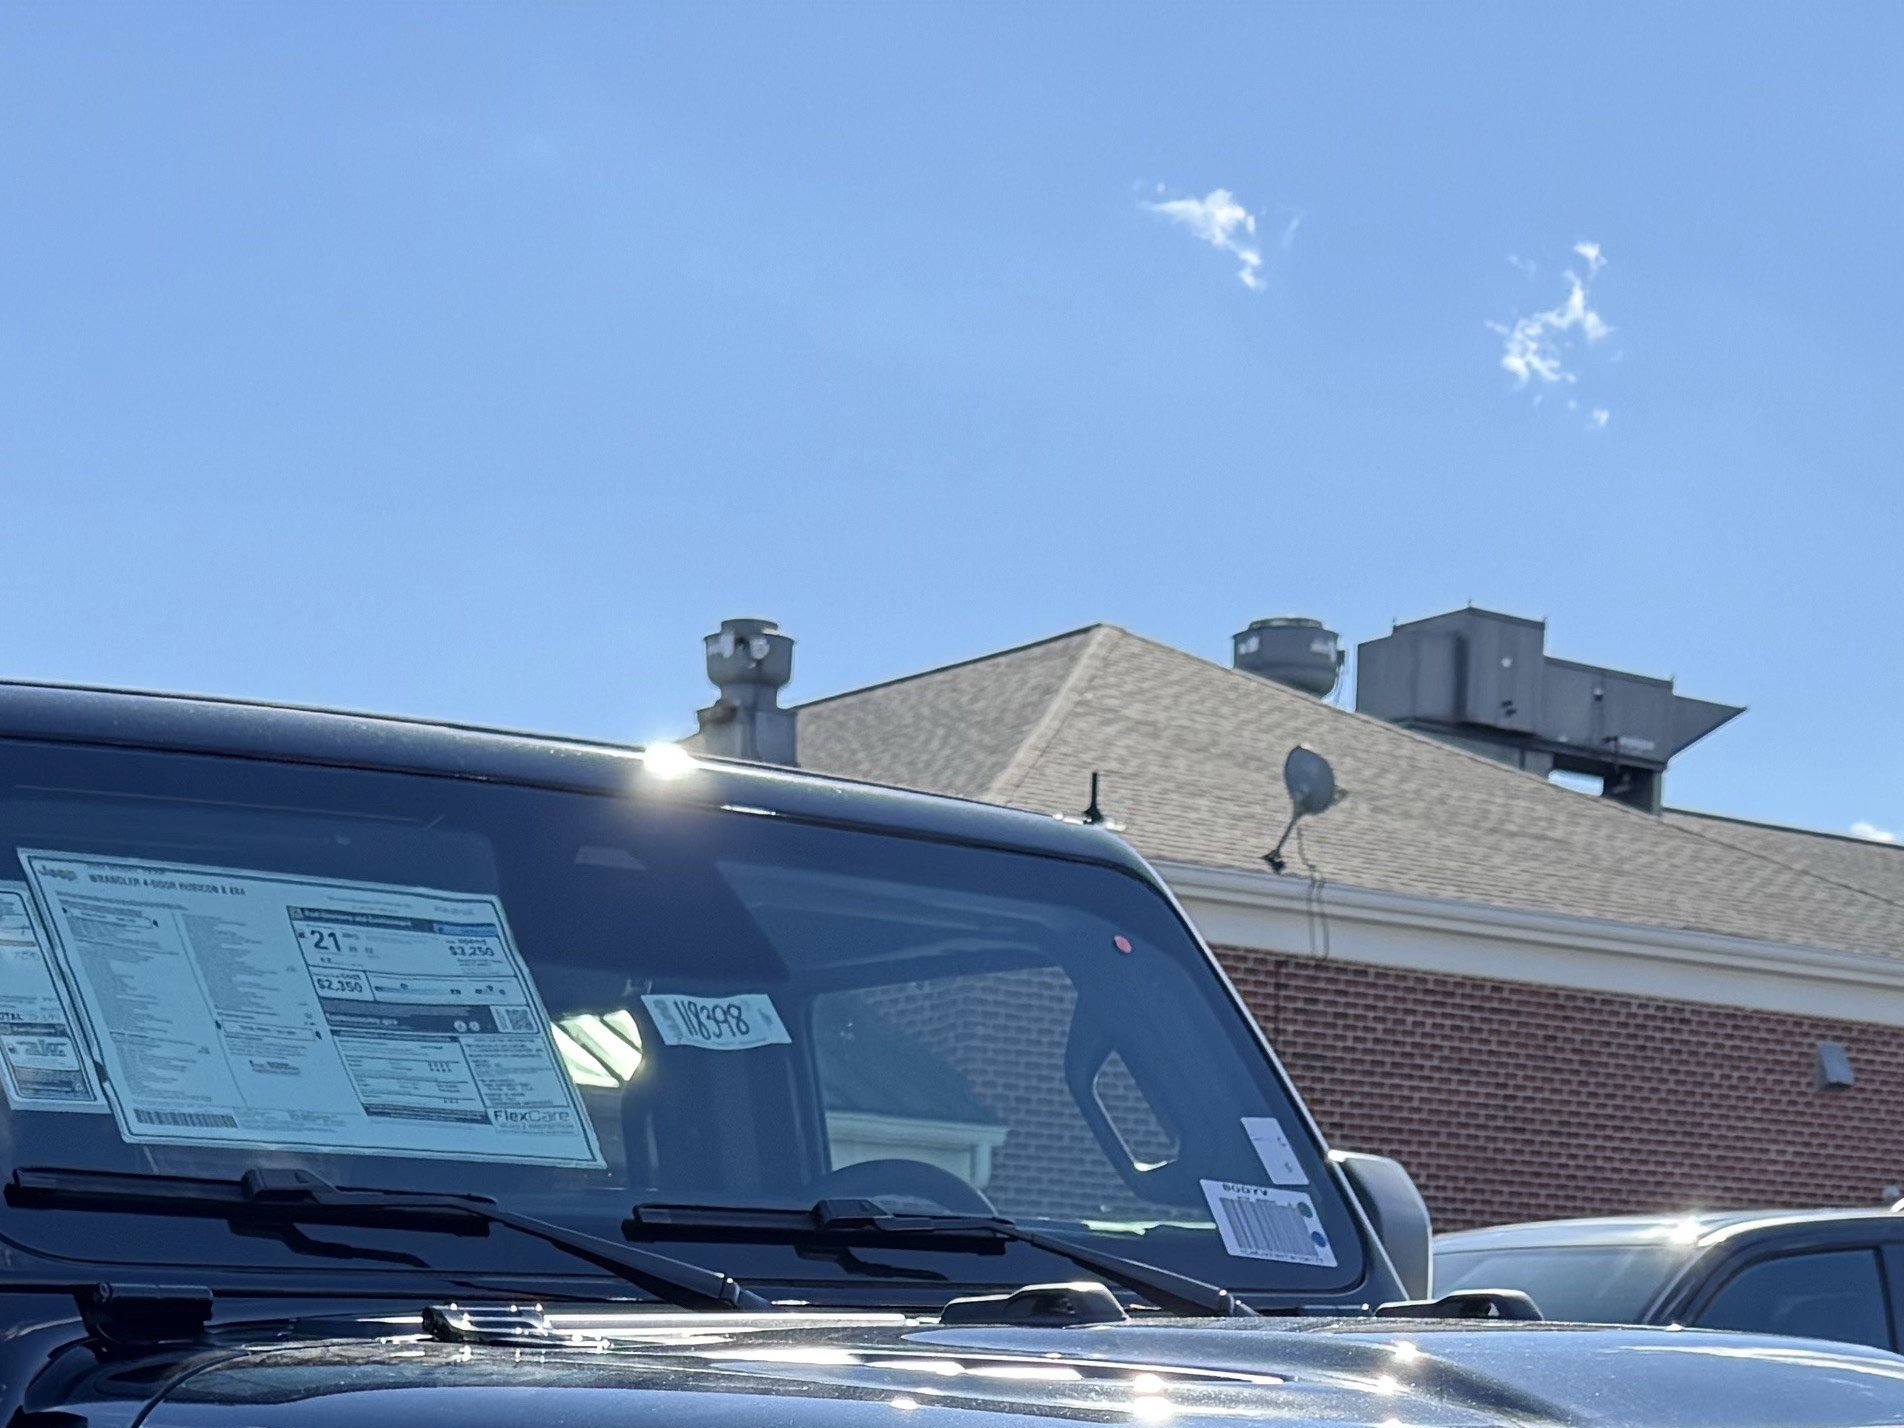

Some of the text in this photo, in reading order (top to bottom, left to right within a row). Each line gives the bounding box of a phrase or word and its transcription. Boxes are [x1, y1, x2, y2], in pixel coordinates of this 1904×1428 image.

[310, 929, 341, 953] 21
[673, 1000, 750, 1041] 118398
[493, 1109, 570, 1123] FlexCare
